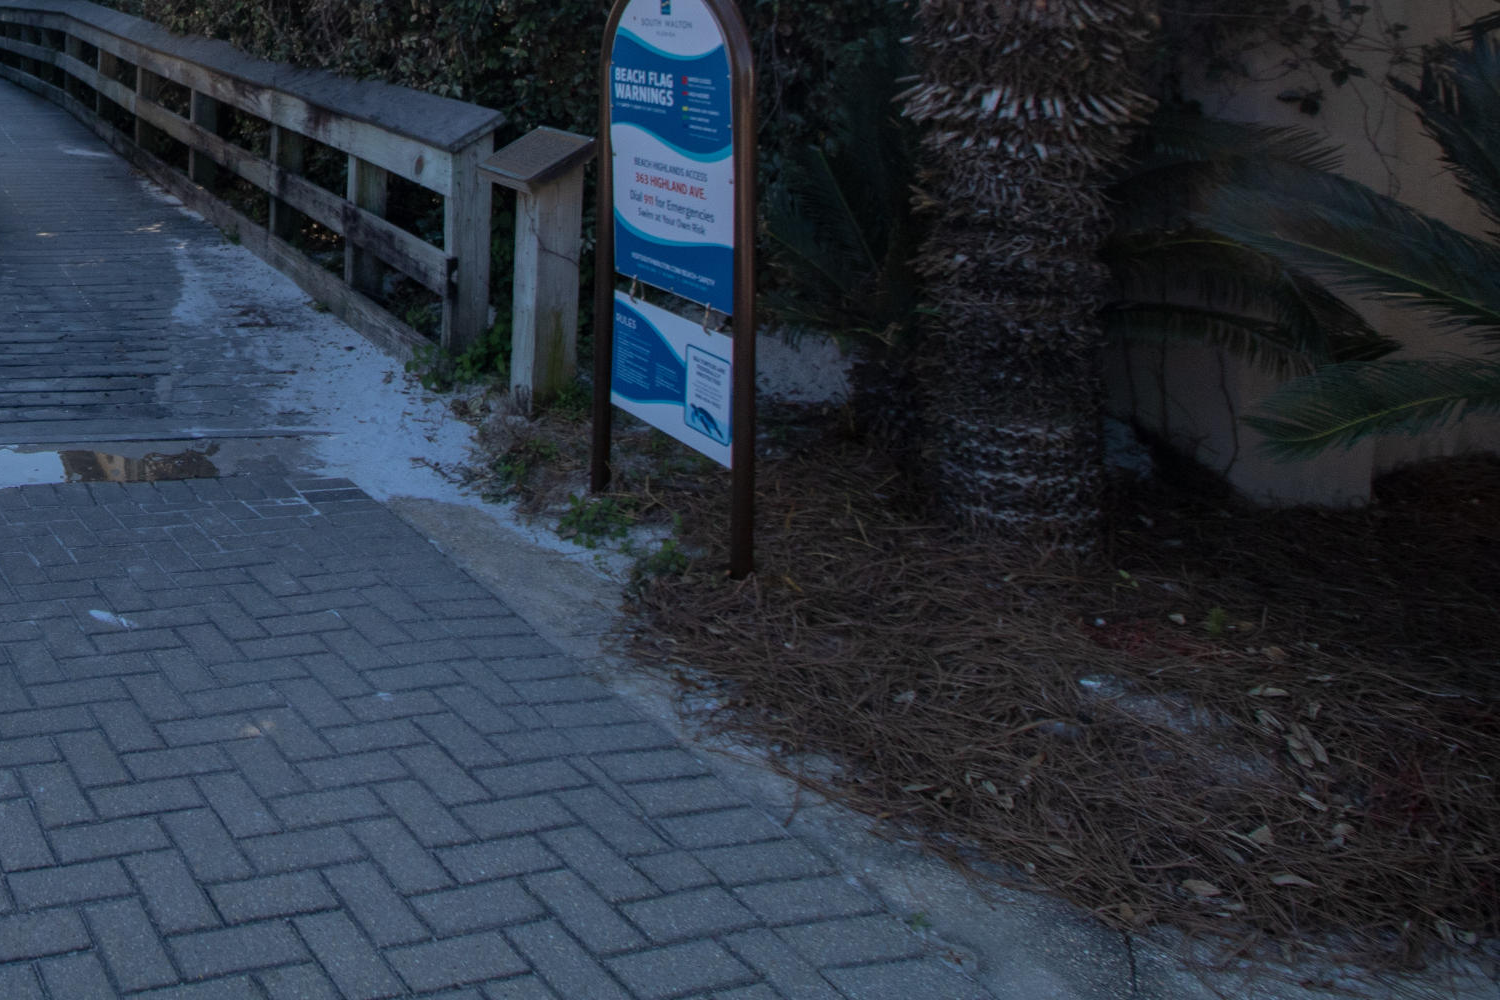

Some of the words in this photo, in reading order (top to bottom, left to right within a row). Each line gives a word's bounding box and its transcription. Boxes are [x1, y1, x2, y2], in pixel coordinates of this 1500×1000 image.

[614, 67, 646, 84] BEACH
[648, 71, 674, 88] FLAG
[614, 82, 674, 107] WARNINGS
[634, 157, 652, 168] BEACH
[652, 161, 685, 177] HIGHLANDS
[685, 169, 708, 182] ACCESS
[635, 172, 649, 185] 363
[650, 175, 688, 195] HIGHLAND
[630, 189, 643, 202] Dial
[643, 194, 654, 206] 911
[655, 196, 665, 208] for
[666, 200, 715, 223] Emergencies
[638, 207, 653, 219] Swim
[655, 214, 661, 222] at
[662, 215, 675, 226] Your
[676, 218, 691, 230] Own
[691, 222, 706, 235] Risk
[616, 313, 637, 329] RULES
